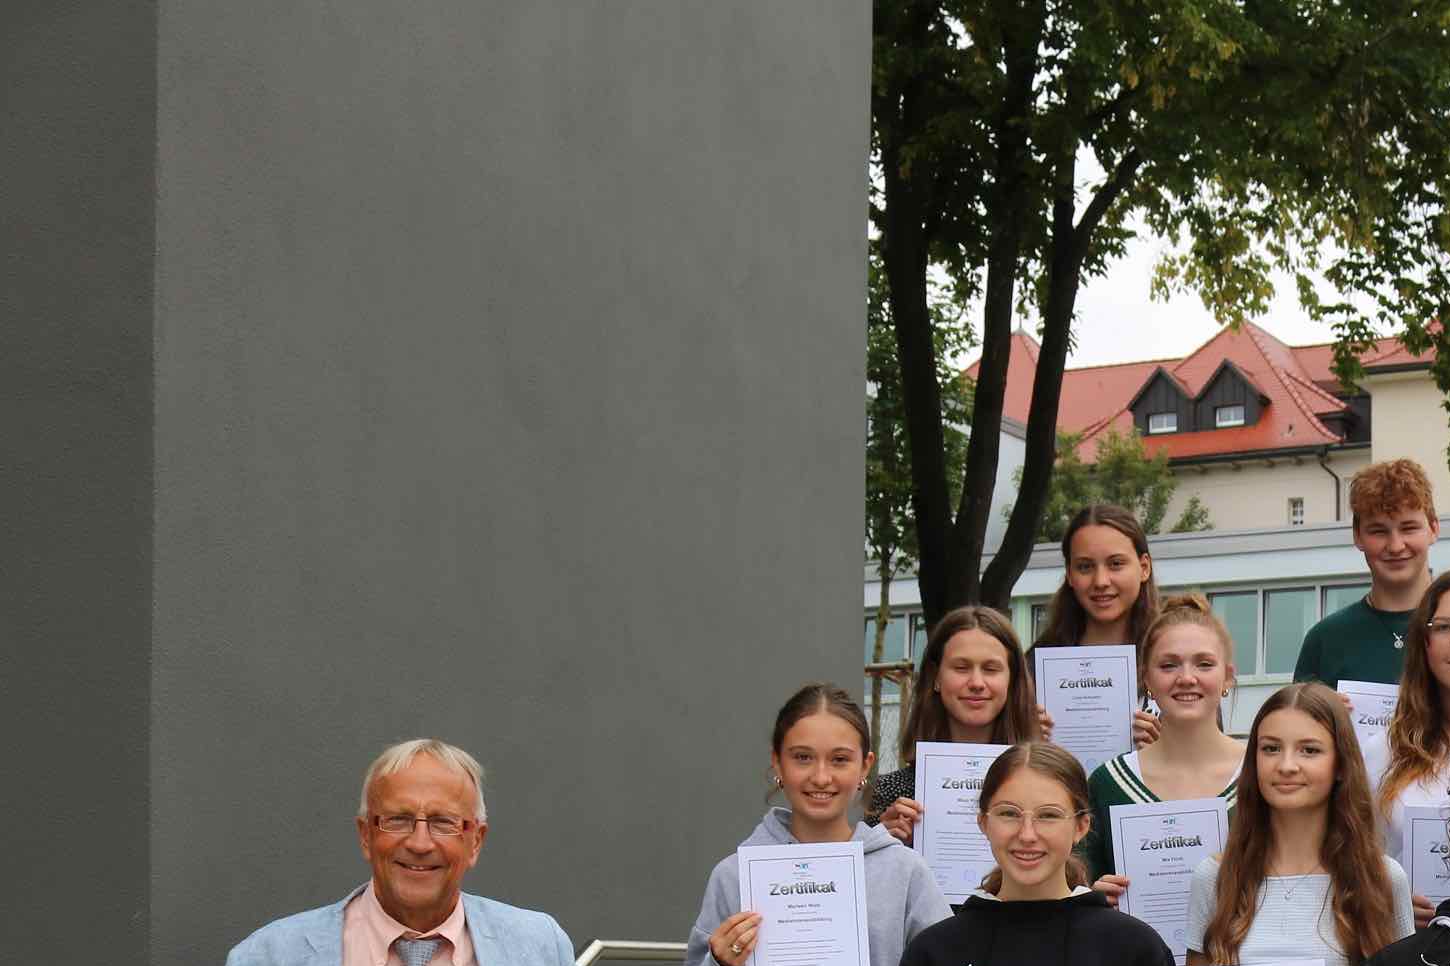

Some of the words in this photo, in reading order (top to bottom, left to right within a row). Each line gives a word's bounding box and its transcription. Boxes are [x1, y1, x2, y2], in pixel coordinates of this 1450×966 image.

[1059, 677, 1113, 689] Zertifikat
[1140, 835, 1203, 851] Zertifikat
[769, 881, 837, 896] Zertifikat
